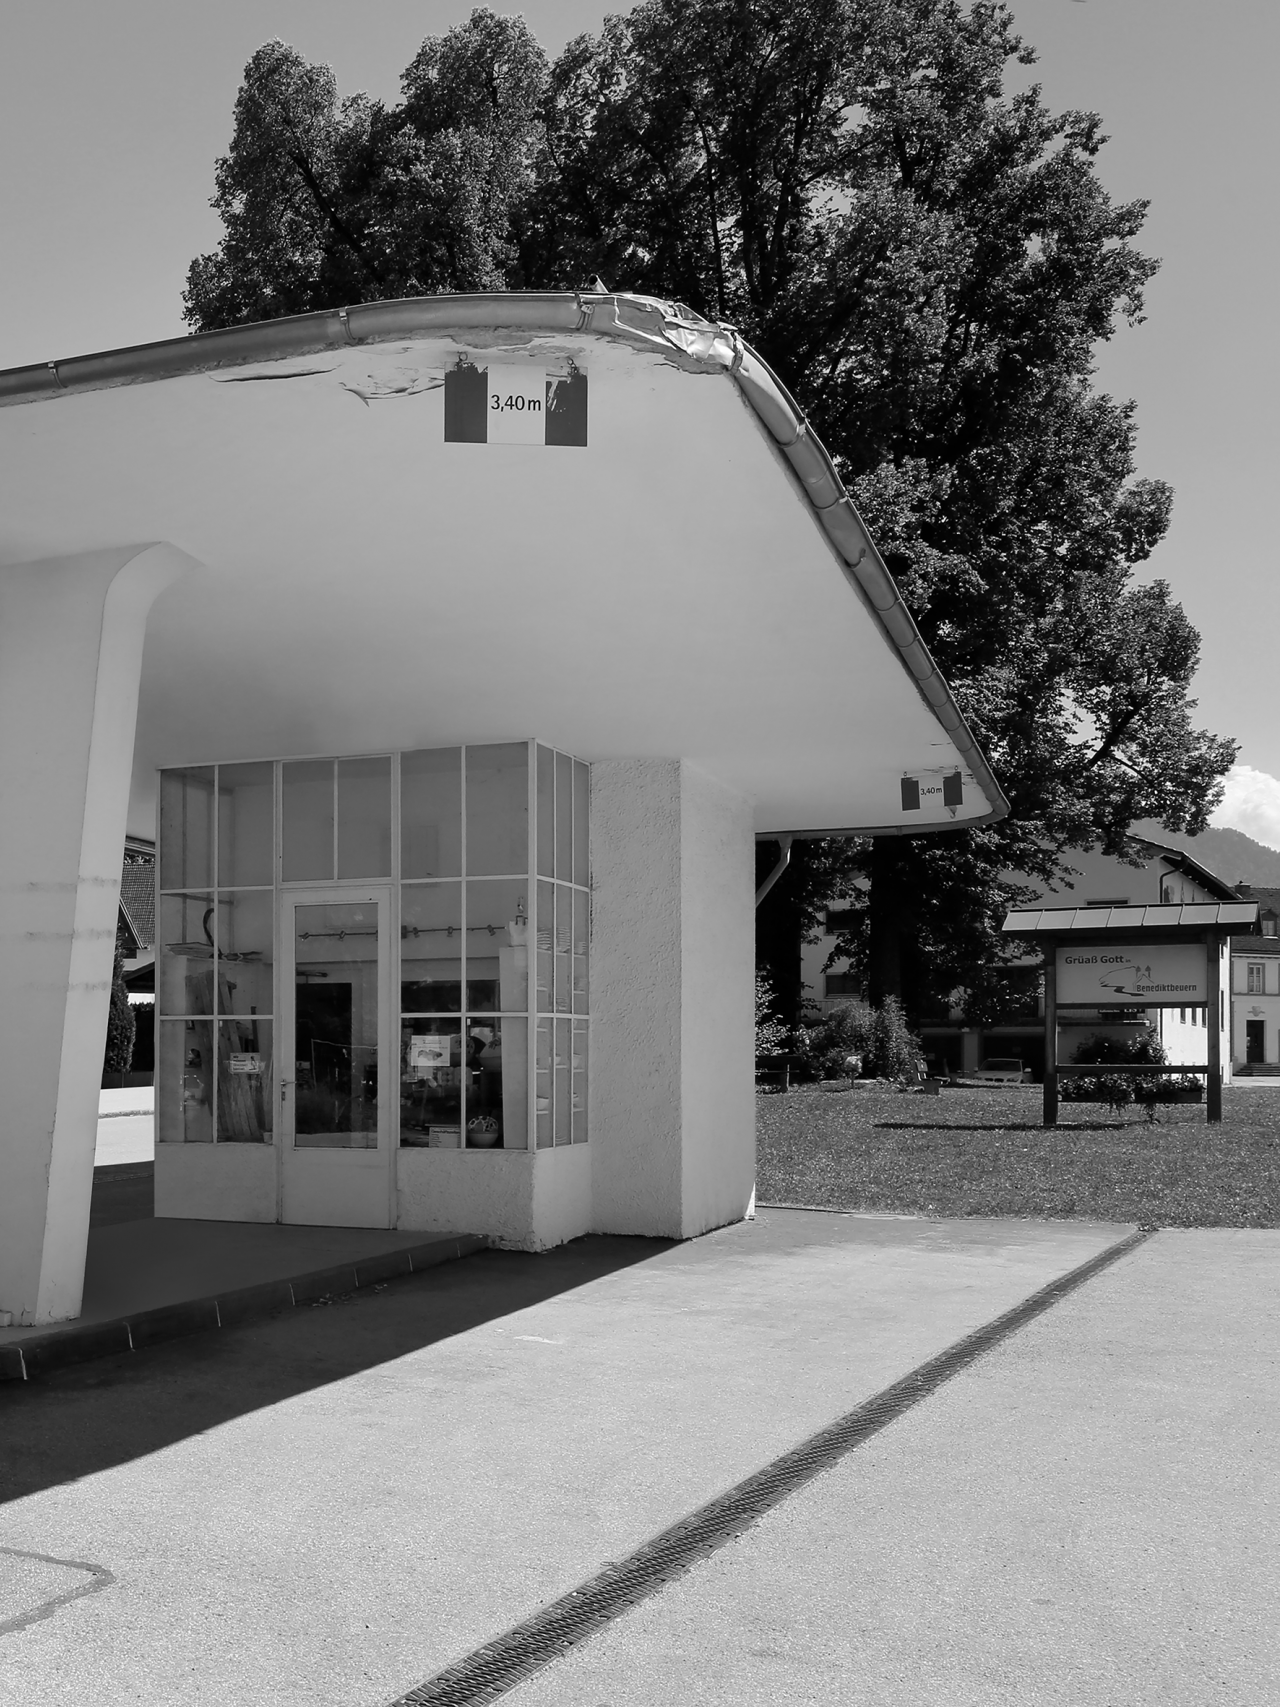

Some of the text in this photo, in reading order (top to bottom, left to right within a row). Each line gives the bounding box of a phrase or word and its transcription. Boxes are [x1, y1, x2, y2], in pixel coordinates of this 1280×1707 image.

[1065, 955, 1098, 964] Grüaß
[1100, 955, 1124, 964] Gott
[1136, 984, 1197, 992] Benediktbeuern
